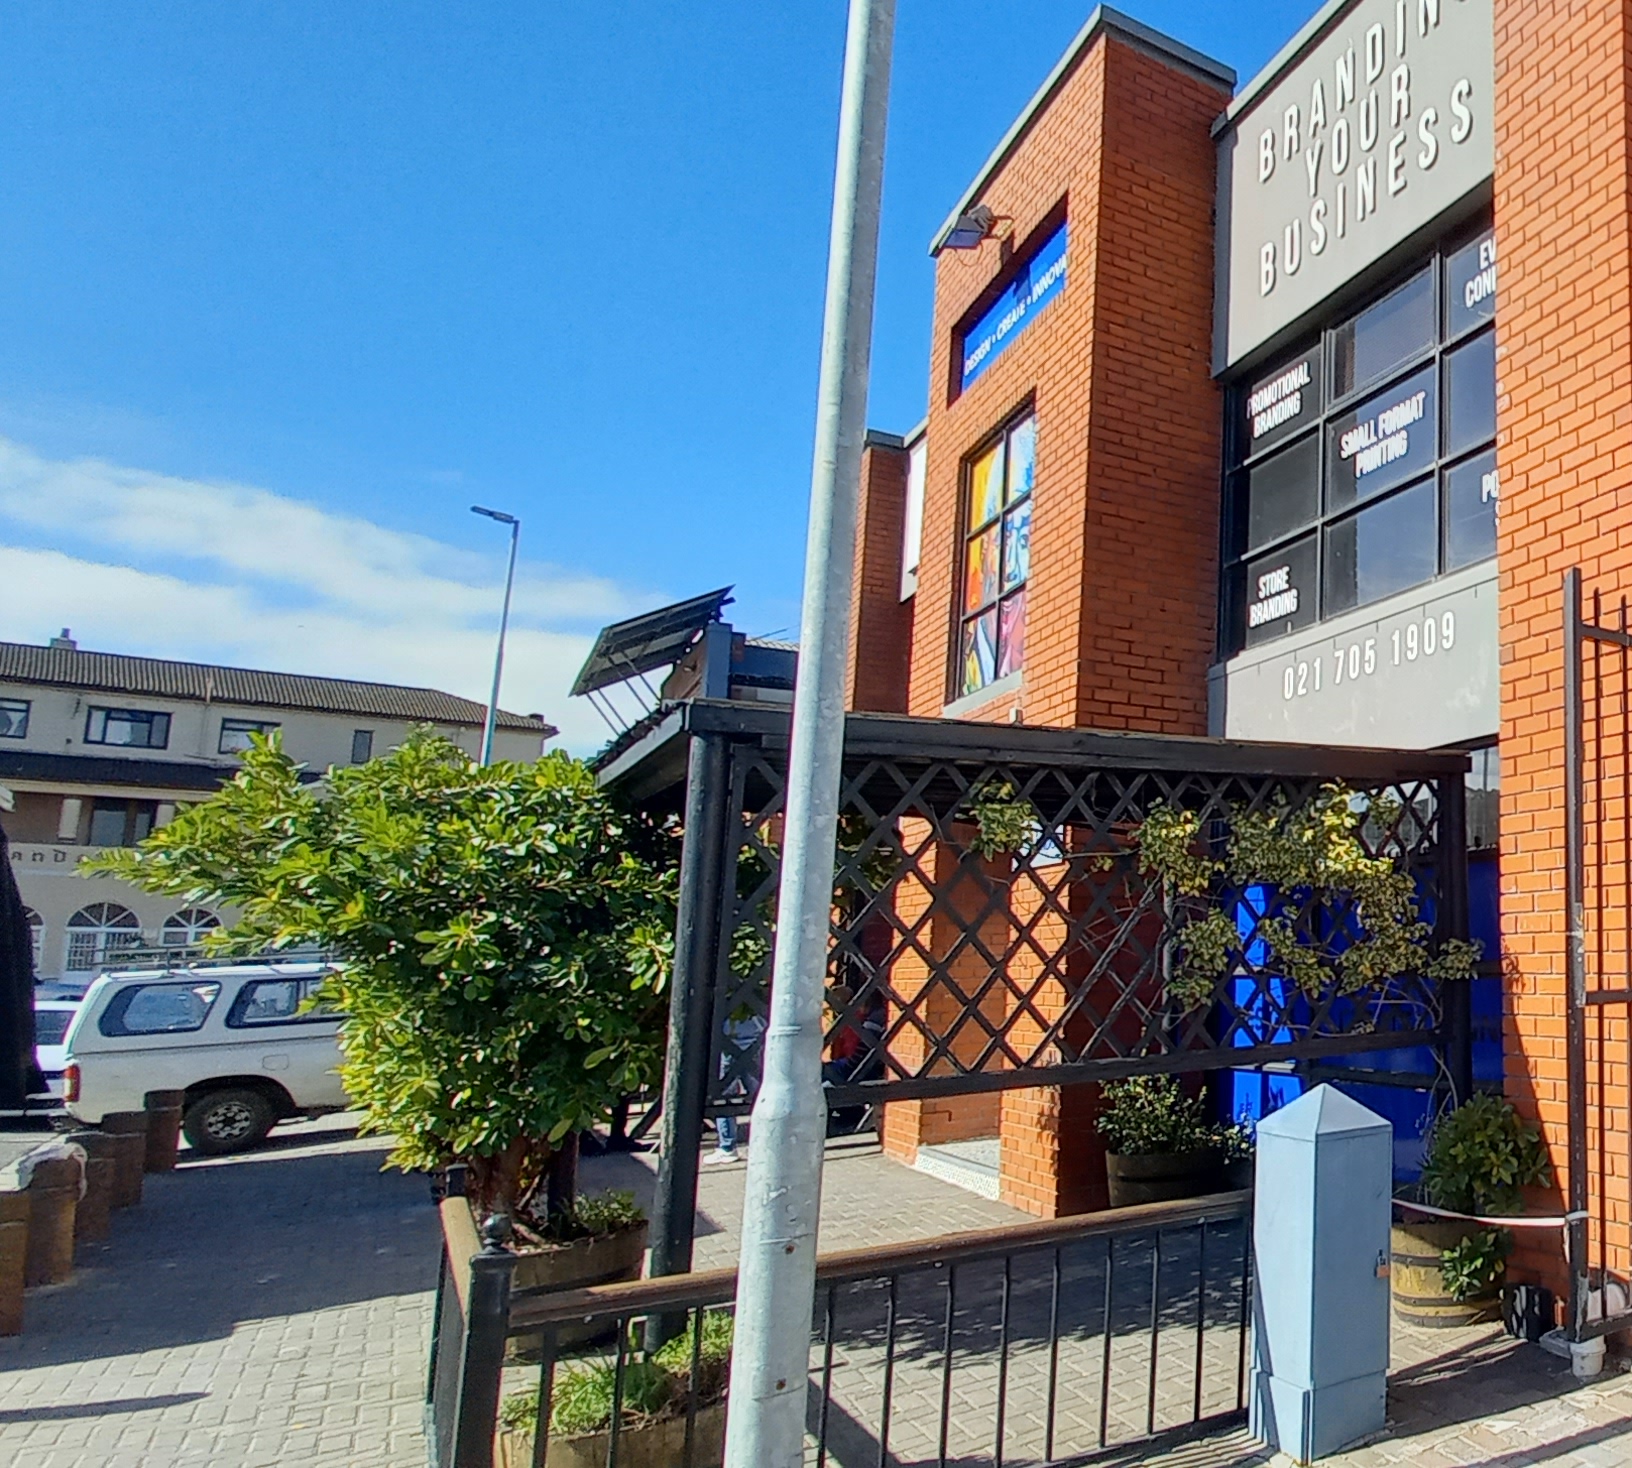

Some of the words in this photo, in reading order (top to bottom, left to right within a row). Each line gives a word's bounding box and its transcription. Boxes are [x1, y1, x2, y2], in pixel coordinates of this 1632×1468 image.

[1258, 0, 1465, 184] BRANDIN
[1306, 63, 1410, 197] YOUR
[1260, 78, 1472, 297] BUSINESS
[1246, 361, 1311, 419] PROMOTIONAL
[1253, 390, 1301, 439] BRANDING
[1340, 419, 1377, 459] SMALL
[1378, 390, 1426, 439] FORMAT
[1355, 429, 1408, 478] PRINTING
[1248, 588, 1298, 628] BRANDING
[1258, 565, 1290, 600] STORE
[1284, 657, 1322, 700] 021
[1333, 638, 1376, 685] 705
[1391, 611, 1456, 666] 1909
